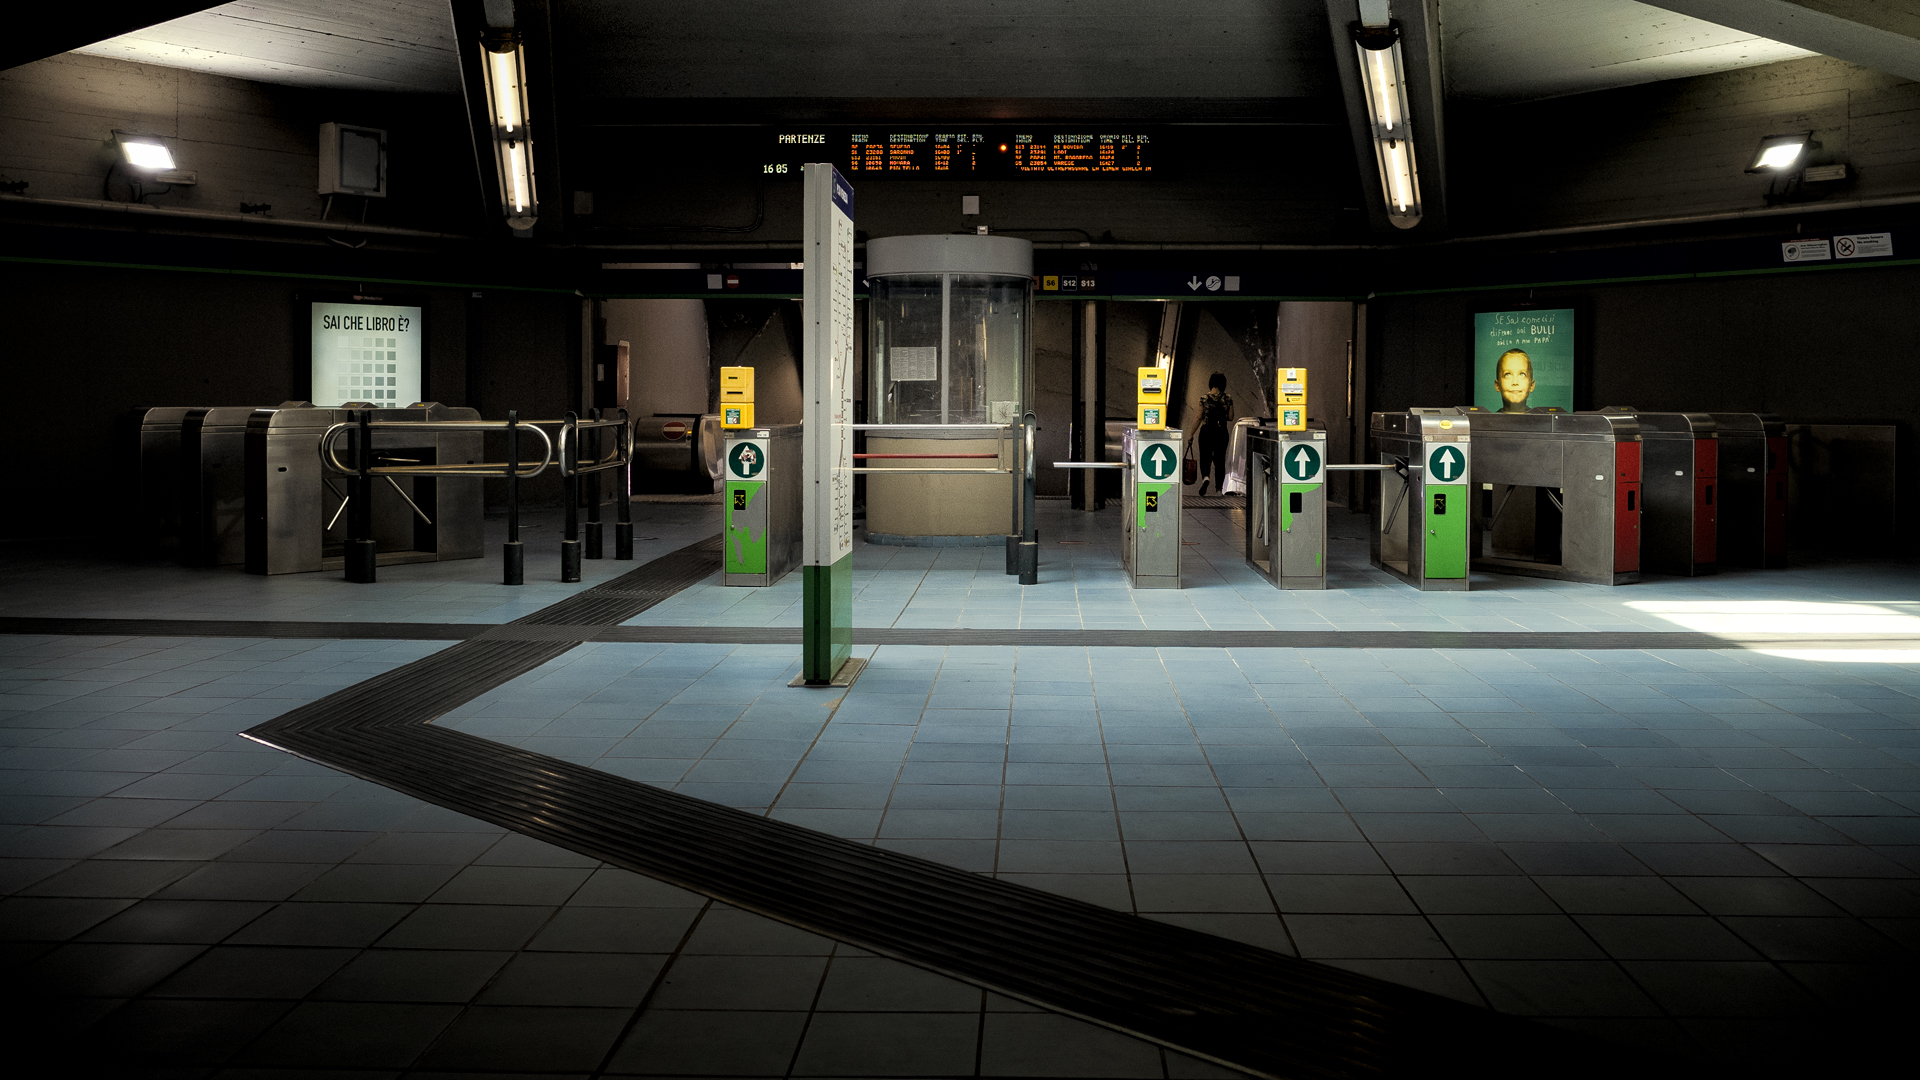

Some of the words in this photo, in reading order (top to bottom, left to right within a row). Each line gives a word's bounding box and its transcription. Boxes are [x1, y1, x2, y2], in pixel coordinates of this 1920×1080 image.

[778, 134, 826, 144] PARTENZE
[323, 314, 341, 330] SAI
[343, 315, 364, 330] CHE
[366, 316, 395, 332] LIBRO
[398, 314, 410, 332] È?
[1494, 313, 1504, 325] SE
[1530, 324, 1555, 336] BULLI
